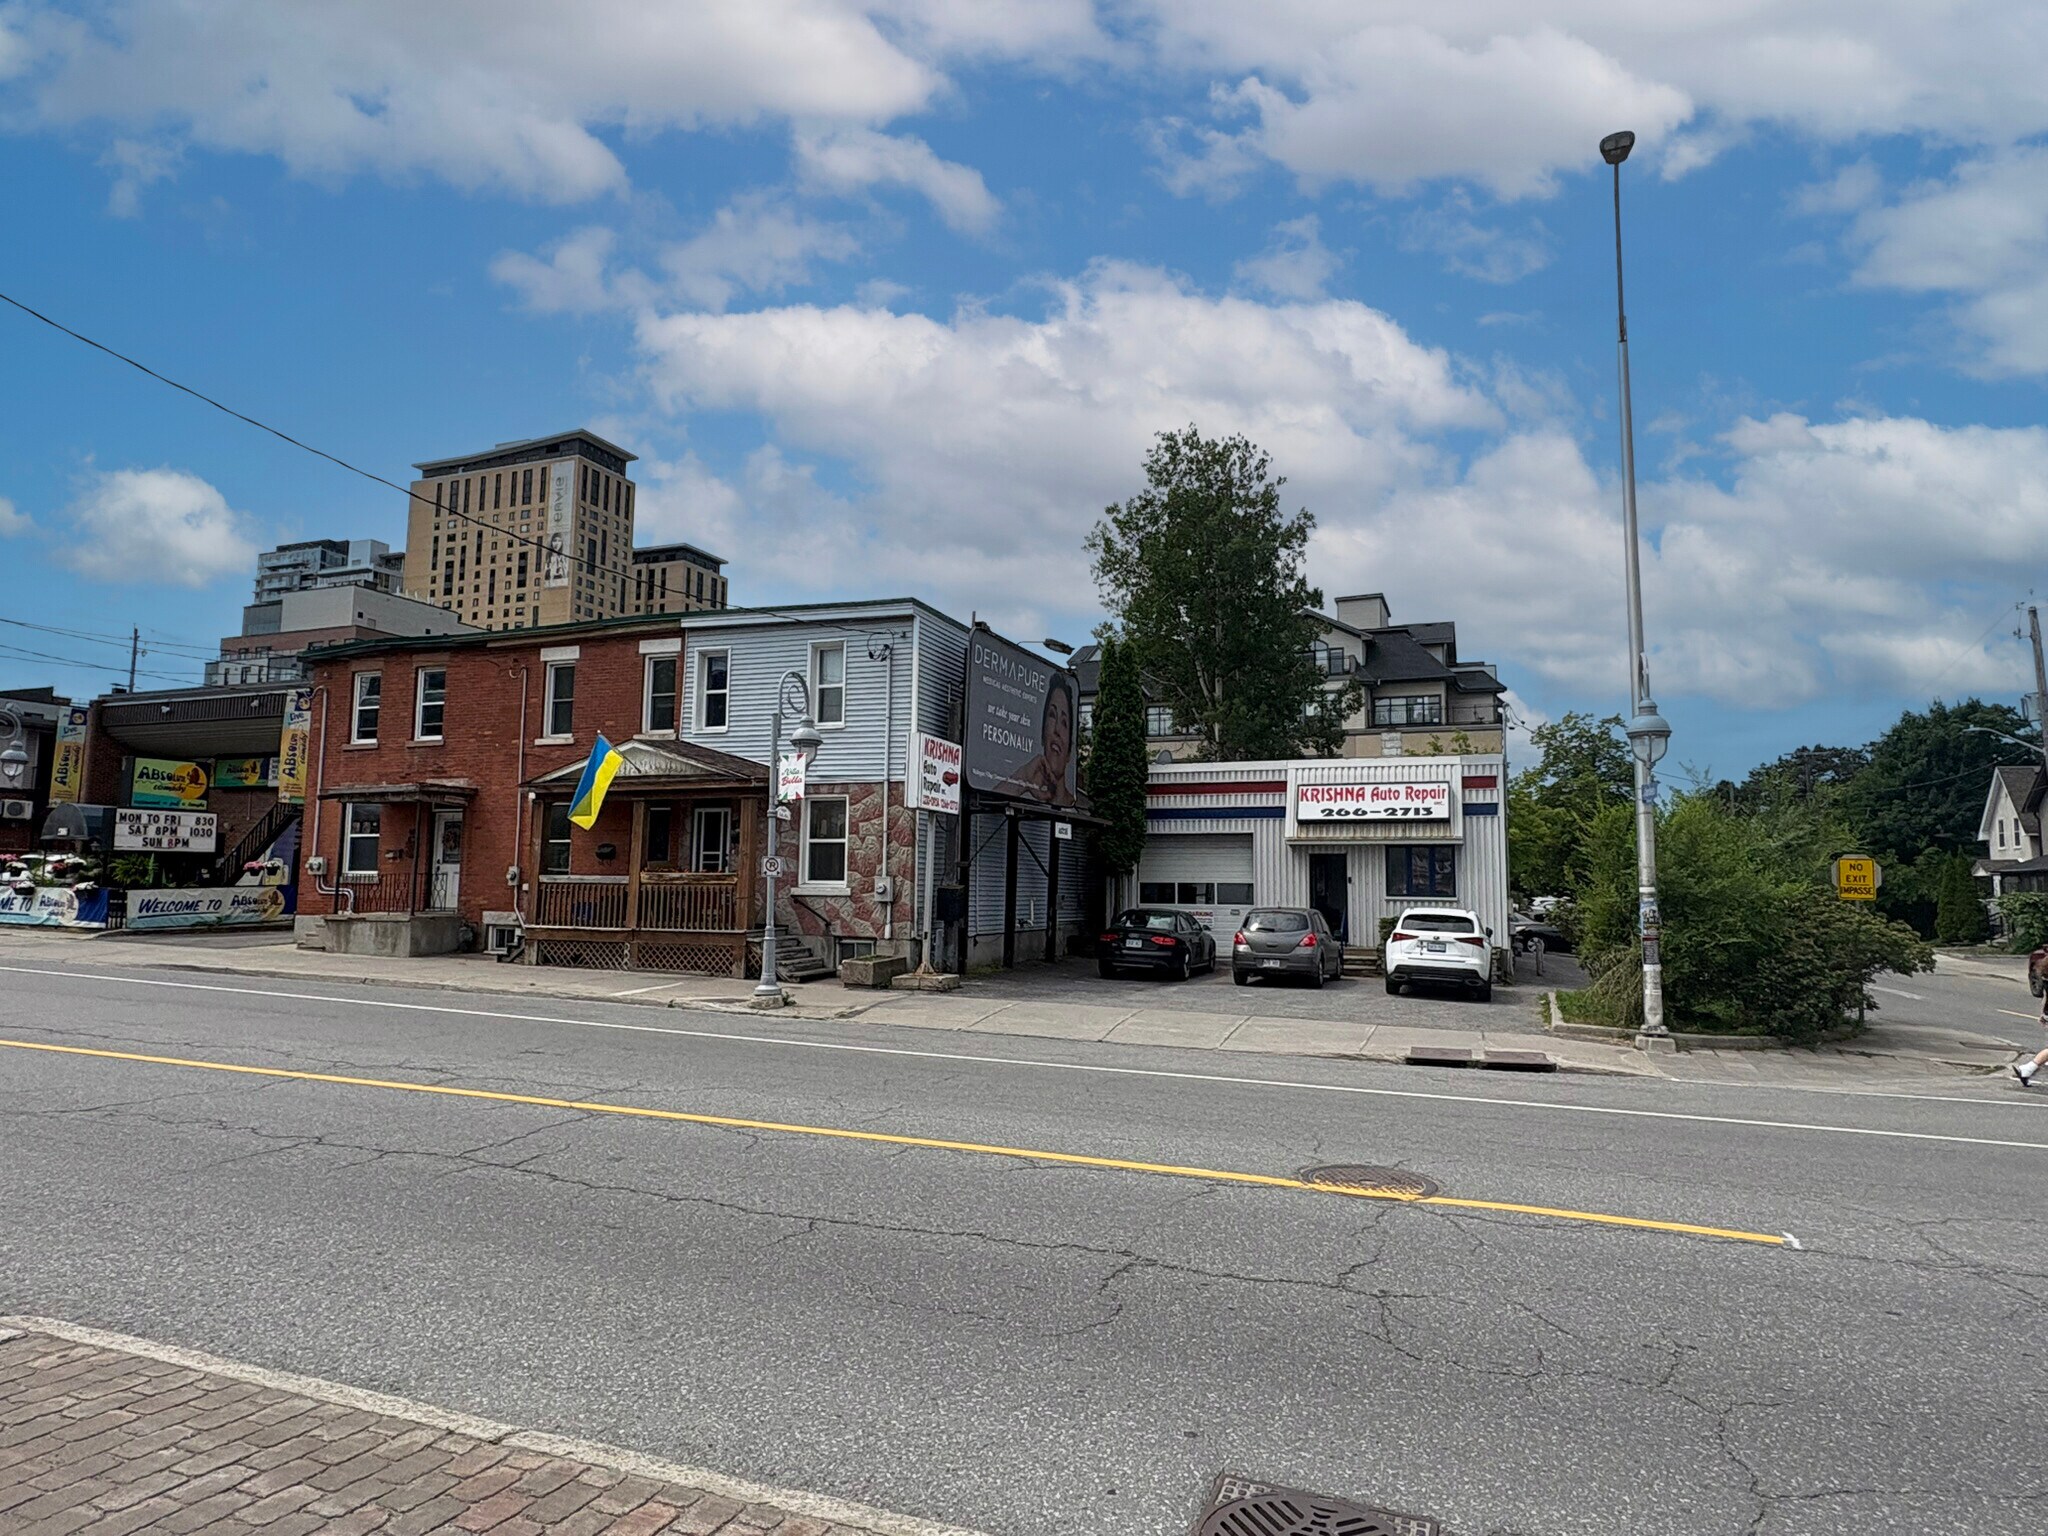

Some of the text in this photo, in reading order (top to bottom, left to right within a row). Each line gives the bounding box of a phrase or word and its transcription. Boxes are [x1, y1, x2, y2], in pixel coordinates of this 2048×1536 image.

[974, 644, 1046, 693] DERMAPURE
[982, 723, 1034, 753] PERSONALLY
[924, 737, 960, 766] KRISHNA
[923, 760, 938, 776] Auto
[923, 776, 942, 795] Repair
[1300, 785, 1447, 804] KRISHNA Auto Repair
[119, 812, 215, 827] MON TO FRI 830
[1320, 807, 1434, 818] 266-2713
[128, 824, 213, 837] SAT 8PM 1030
[142, 836, 190, 848] SUN 8PM
[1849, 863, 1864, 871] NO
[1845, 874, 1868, 883] EXIT
[19, 896, 34, 912] TO
[138, 898, 223, 913] WELCOME TO
